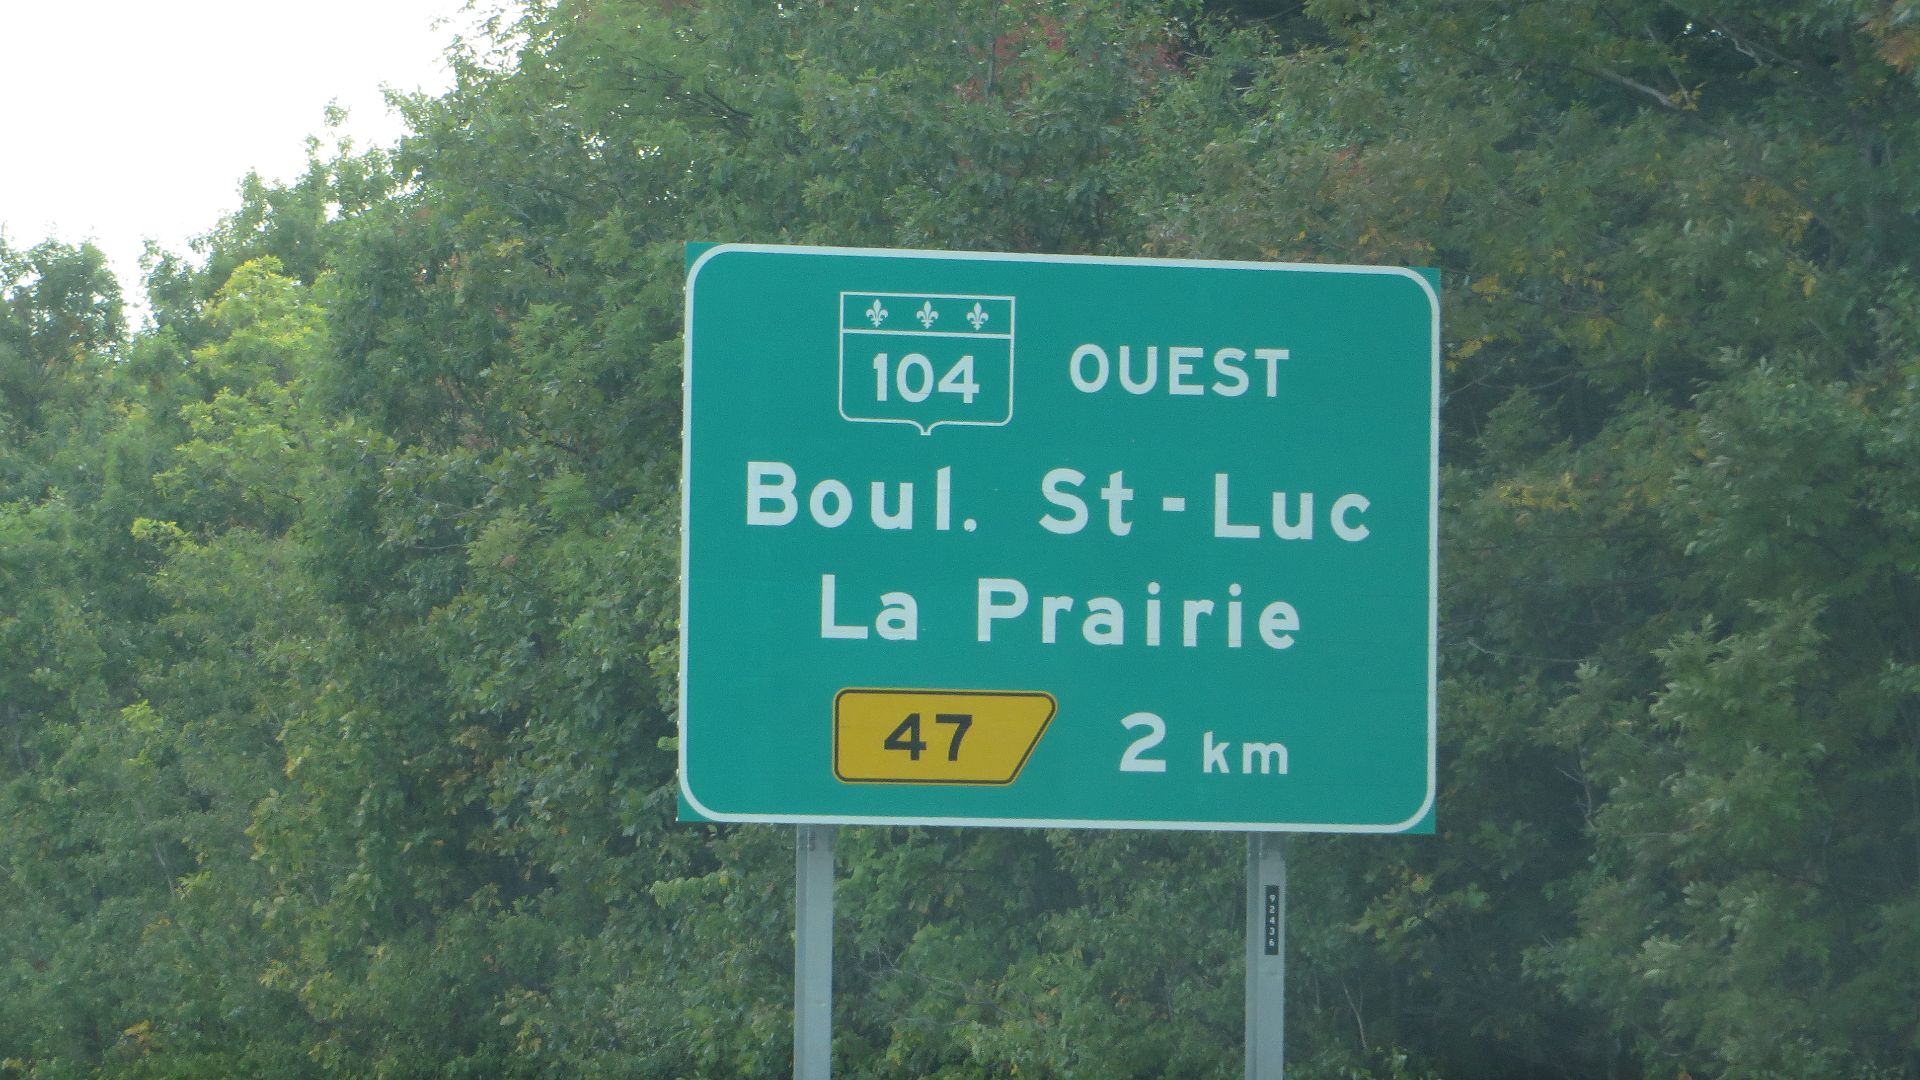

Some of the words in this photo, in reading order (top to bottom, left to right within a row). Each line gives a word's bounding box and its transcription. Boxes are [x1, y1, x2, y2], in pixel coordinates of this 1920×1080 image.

[873, 352, 980, 404] 104
[1069, 343, 1291, 398] OUEST
[746, 461, 977, 532] Boul.
[820, 574, 918, 641] La
[977, 577, 1300, 650] Prairie
[884, 714, 973, 763] 47
[1119, 711, 1166, 773] 2
[1203, 731, 1289, 776] km
